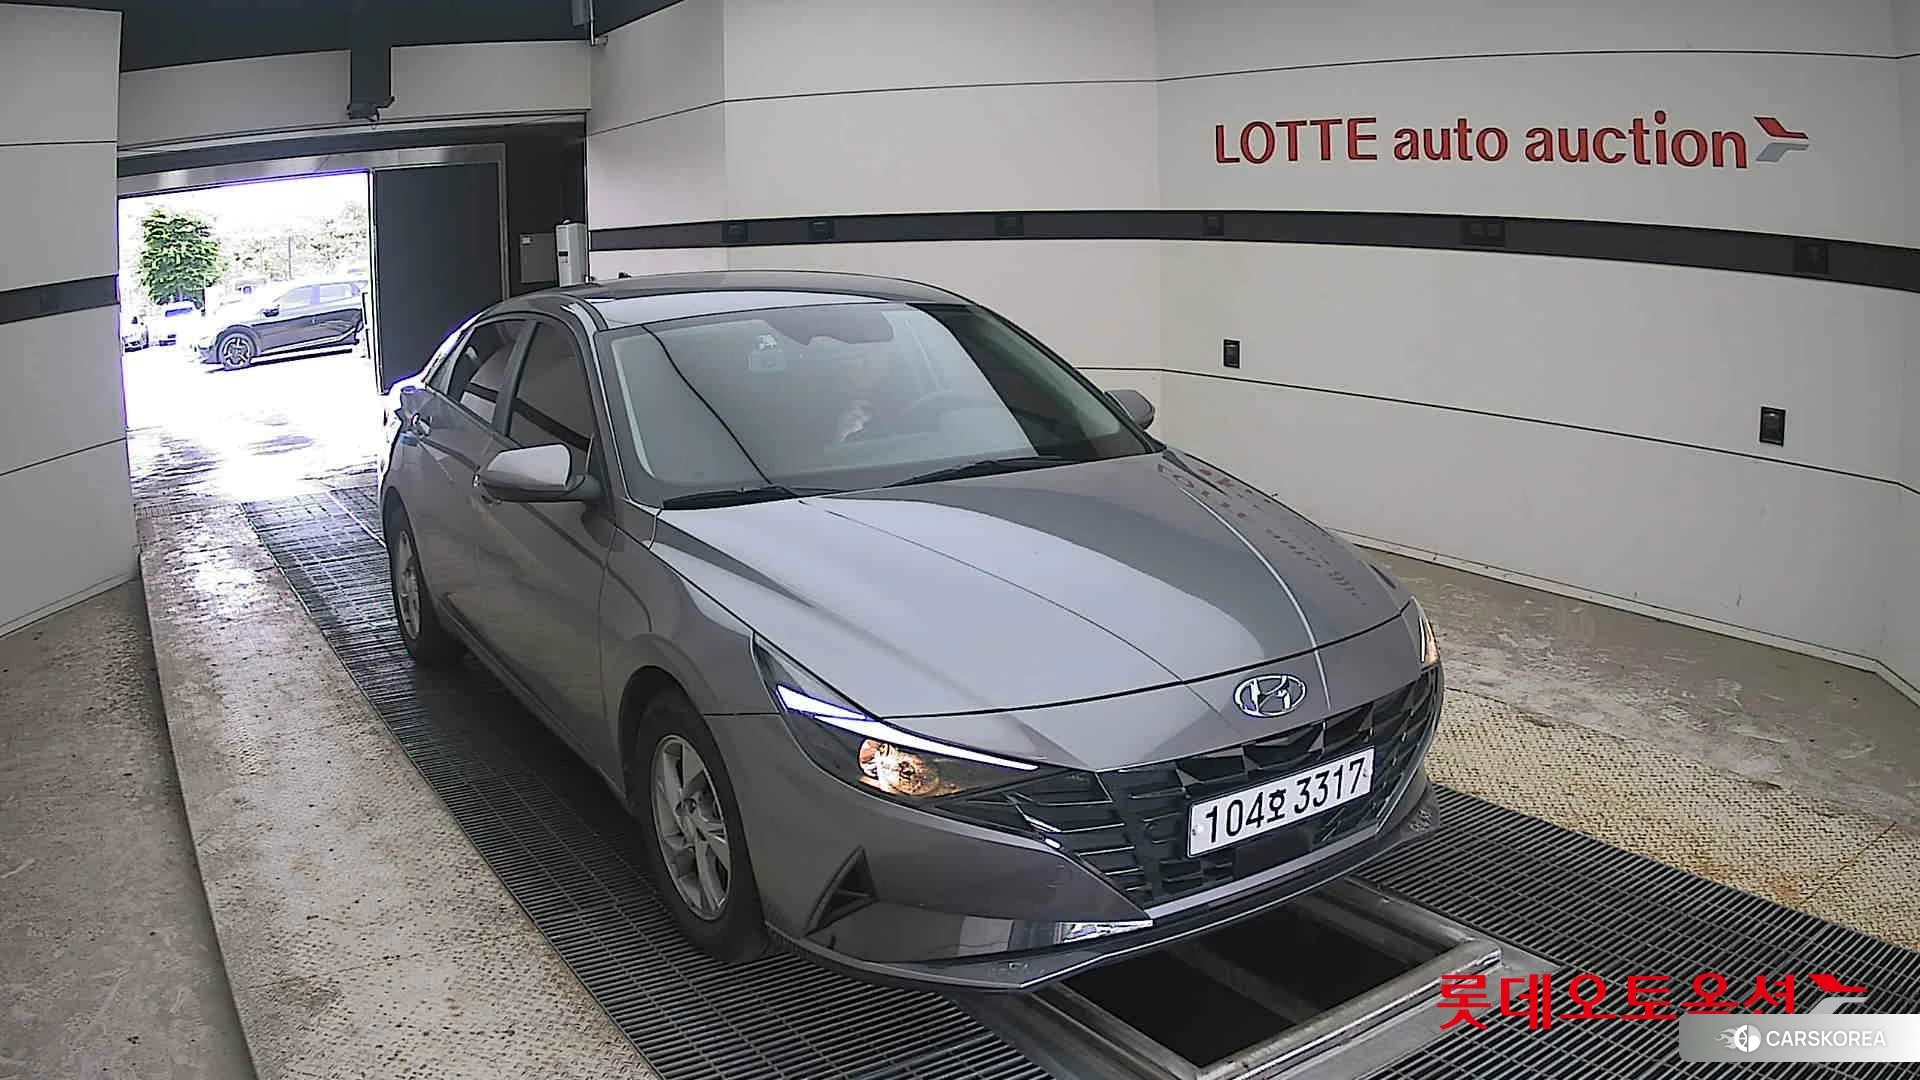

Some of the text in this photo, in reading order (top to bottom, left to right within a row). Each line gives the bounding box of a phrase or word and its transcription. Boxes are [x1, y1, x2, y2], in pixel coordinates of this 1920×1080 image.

[1215, 110, 1748, 169] LOTTE auto auction
[1206, 757, 1366, 843] 104호 3317
